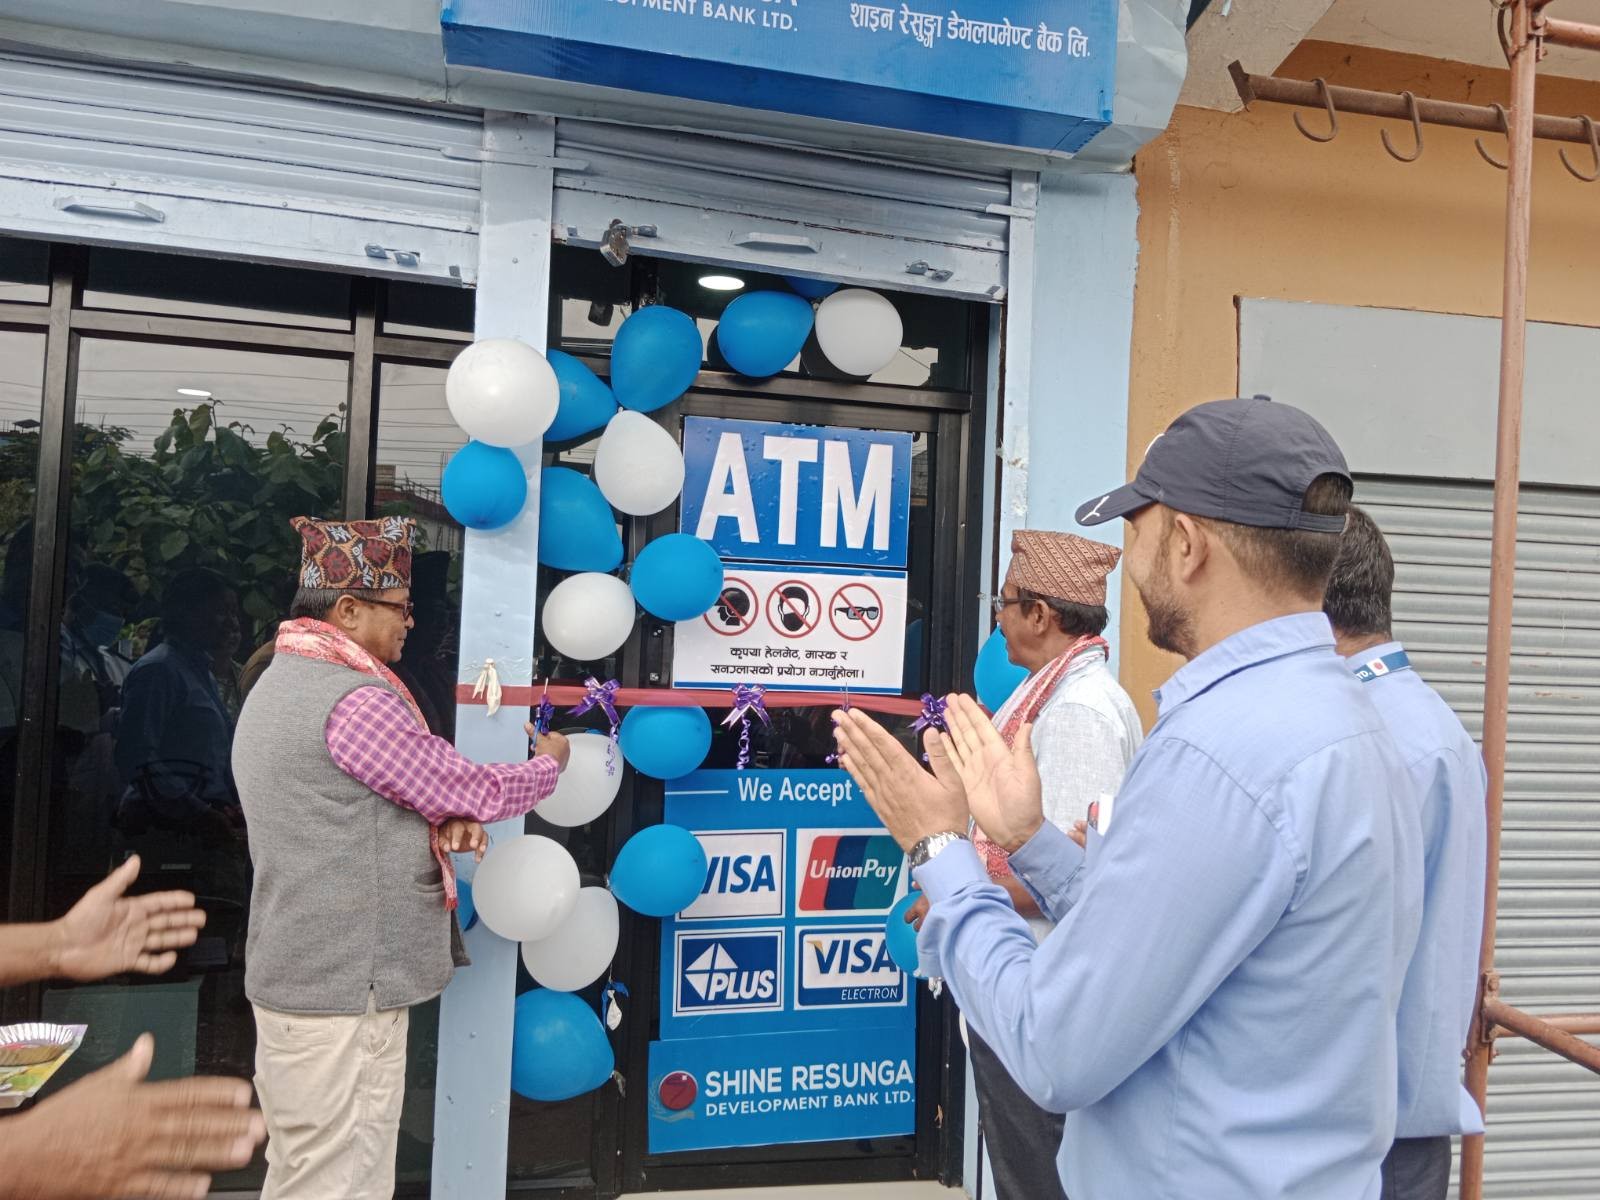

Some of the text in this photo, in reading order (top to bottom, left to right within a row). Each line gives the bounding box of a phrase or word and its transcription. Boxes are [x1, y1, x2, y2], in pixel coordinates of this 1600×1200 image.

[702, 2, 756, 25] BANK
[762, 10, 798, 32] LTD.
[850, 2, 895, 32] शाइन
[1067, 27, 1090, 57] लि.
[696, 432, 893, 551] ATM
[730, 645, 848, 660] कृपया हेलमेट, मास्क र
[777, 664, 806, 676] प्रयोग
[738, 777, 852, 806] We Accept
[809, 858, 898, 886] UnionPay
[806, 938, 898, 974] VISA
[708, 969, 775, 1000] PLUS
[841, 987, 899, 1001] ELECTRON
[704, 1059, 914, 1098] SHINE RESUNGA
[705, 1090, 915, 1117] DEVELOPMENT BANK LTD.
